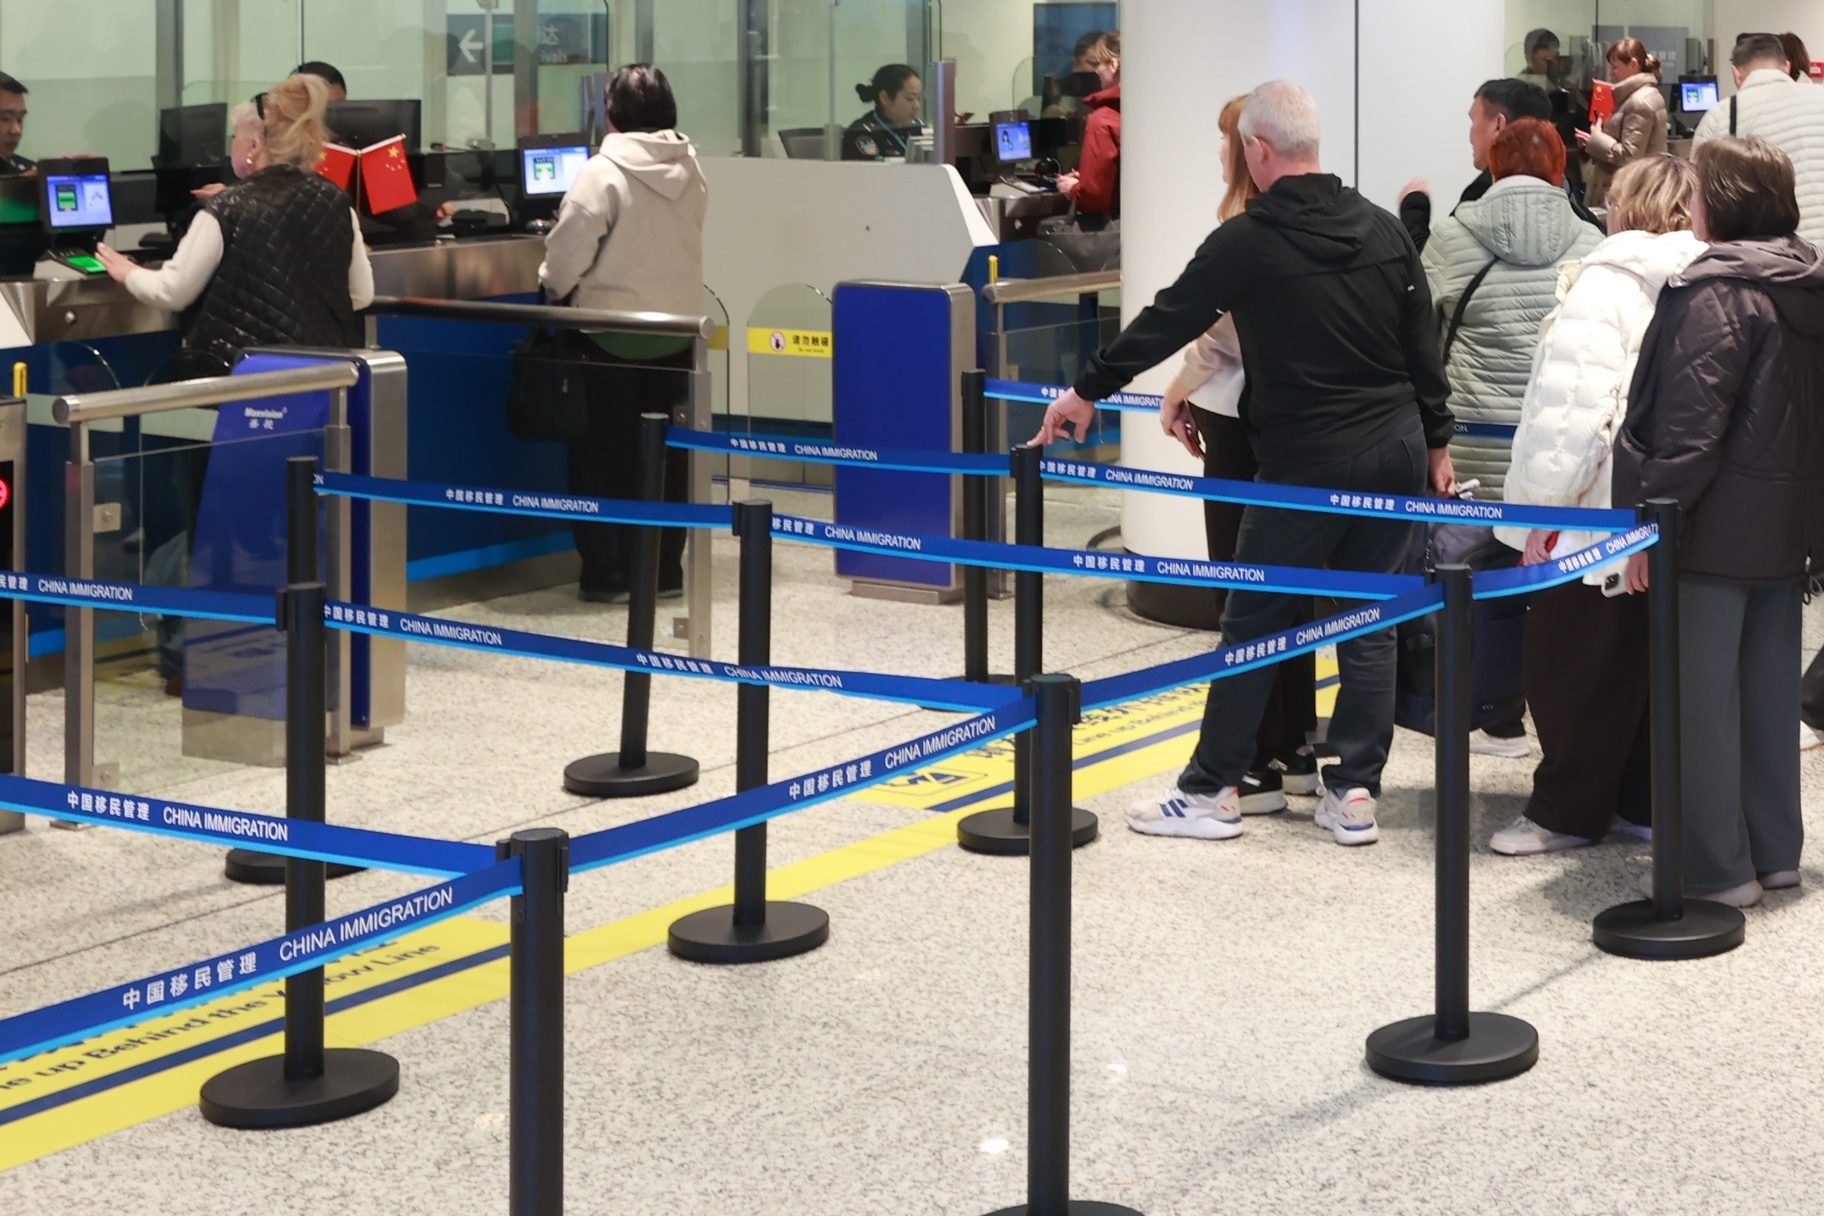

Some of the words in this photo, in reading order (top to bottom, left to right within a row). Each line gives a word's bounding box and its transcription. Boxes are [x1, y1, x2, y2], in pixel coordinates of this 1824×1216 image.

[794, 444, 821, 457] CHINA
[821, 446, 878, 461] IMMIGRATION
[1105, 468, 1133, 483] CHINA
[1134, 473, 1194, 491] IMMIGRATION
[512, 494, 540, 509] CHINA
[540, 497, 599, 513] IMMIGRATION
[1329, 493, 1396, 512] 中国移民管理
[1405, 500, 1435, 515] CHINA
[1437, 503, 1502, 519] IMMIGRATION
[824, 525, 855, 541] CHINA
[856, 530, 921, 550] IMMIGRATION
[1625, 522, 1660, 545] IMMIGRATI
[1073, 554, 1146, 573] 中国移民管理
[1157, 561, 1190, 577] CHINA
[1192, 563, 1265, 582] IMMIGRATION
[38, 578, 68, 595] CHINA
[69, 582, 133, 601] IMMIGRATION
[400, 618, 433, 635] CHINA
[433, 624, 503, 647] IMMIGRATION
[1225, 636, 1287, 666] 中国移民管理
[1296, 627, 1323, 647] CHINA
[1323, 606, 1381, 641] IMMIGRATION
[723, 665, 762, 680] CHINA
[761, 670, 843, 688] IMMIGRATION
[788, 760, 873, 801] 中国移民管理
[884, 738, 920, 769] CHINA
[922, 714, 996, 759] IMMIGRATION
[66, 789, 150, 821] 中国移民管理
[162, 806, 202, 829] CHINA
[203, 812, 289, 842] IMMIGRATION
[122, 950, 258, 1012] 中国移民管理
[279, 929, 336, 962] CHINA
[339, 886, 454, 942] IMMIGRATION
